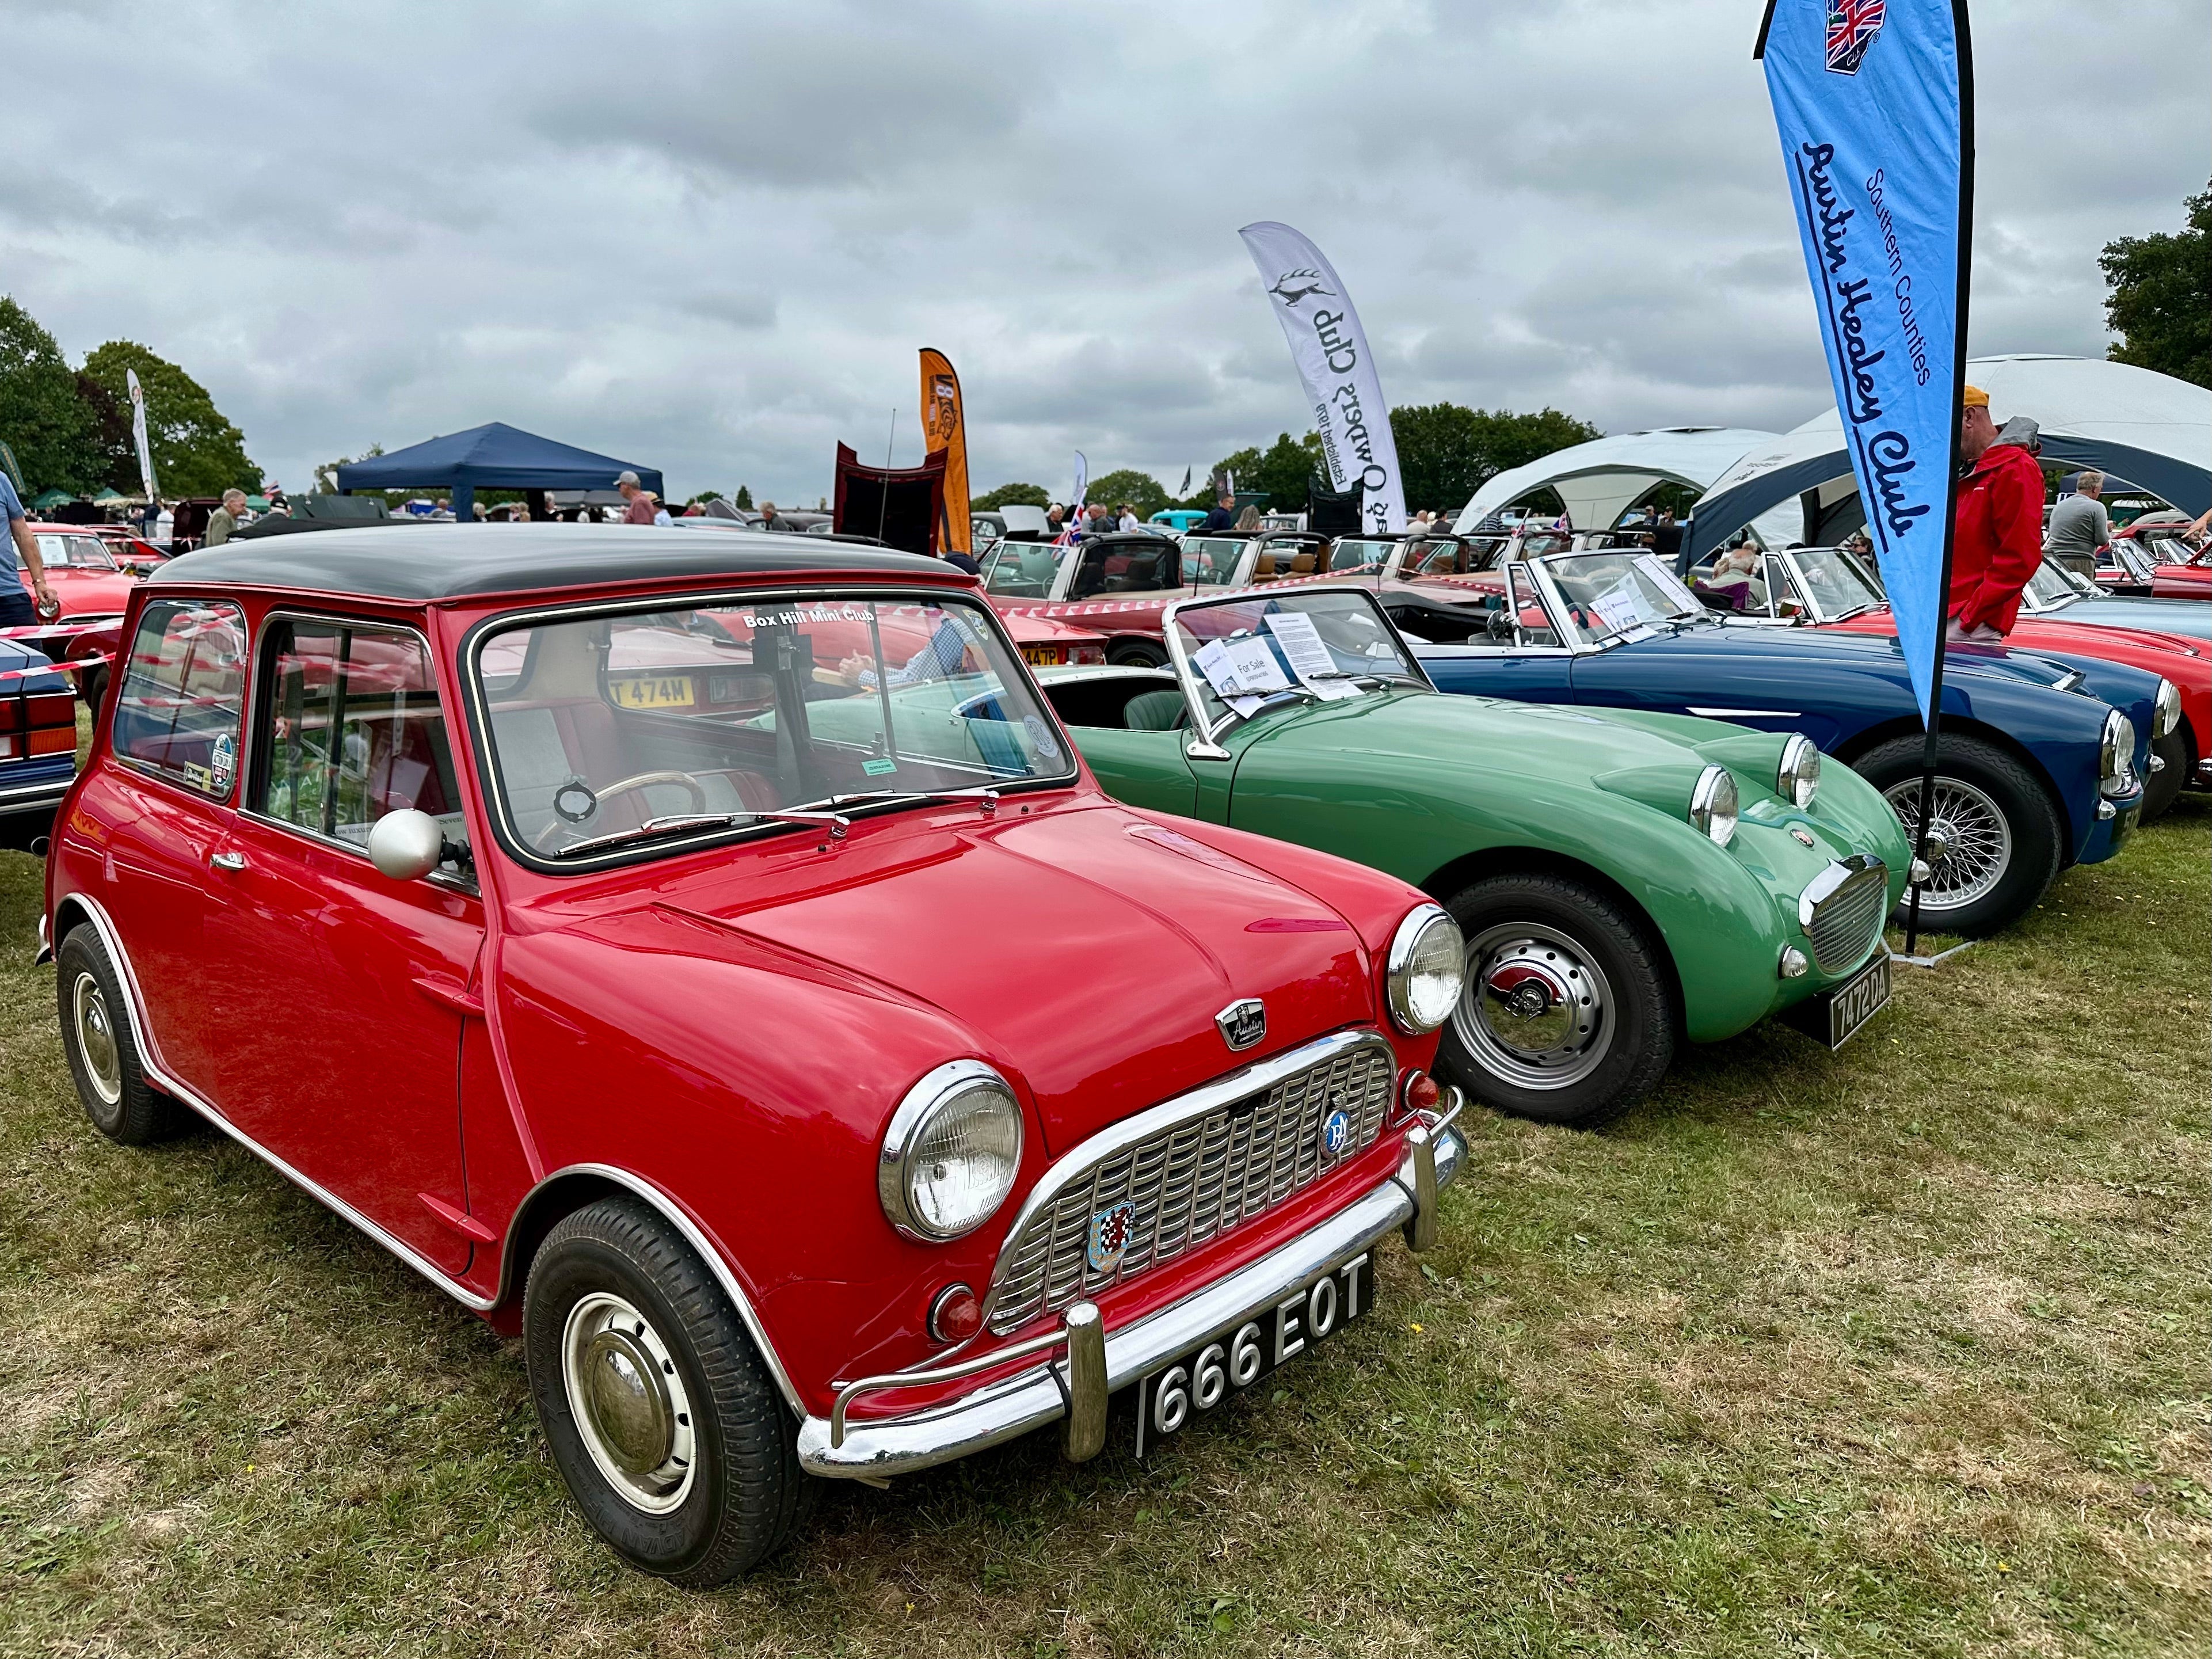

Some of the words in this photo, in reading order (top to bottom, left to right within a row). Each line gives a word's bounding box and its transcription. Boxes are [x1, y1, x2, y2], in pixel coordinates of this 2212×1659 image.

[1846, 46, 1861, 66] Club
[1865, 168, 1904, 277] Southern
[1894, 275, 1931, 386] Counties
[1802, 142, 1855, 275] Austin
[1836, 277, 1885, 424] Healey
[1868, 430, 1931, 538] Club
[935, 374, 954, 399] V8
[743, 615, 777, 628] Box
[778, 611, 808, 625] Hill
[808, 609, 842, 622] Mini
[842, 609, 874, 622] Club
[1237, 664, 1250, 674] For
[1249, 659, 1266, 670] Sale
[631, 679, 686, 703] 474M
[438, 817, 462, 825] Seven
[1232, 1016, 1263, 1041] Austin
[532, 1297, 553, 1397] YOKOHAMA
[1154, 1321, 1261, 1433] 666
[1274, 1252, 1368, 1366] EOT
[620, 1525, 686, 1555] ADVAN
